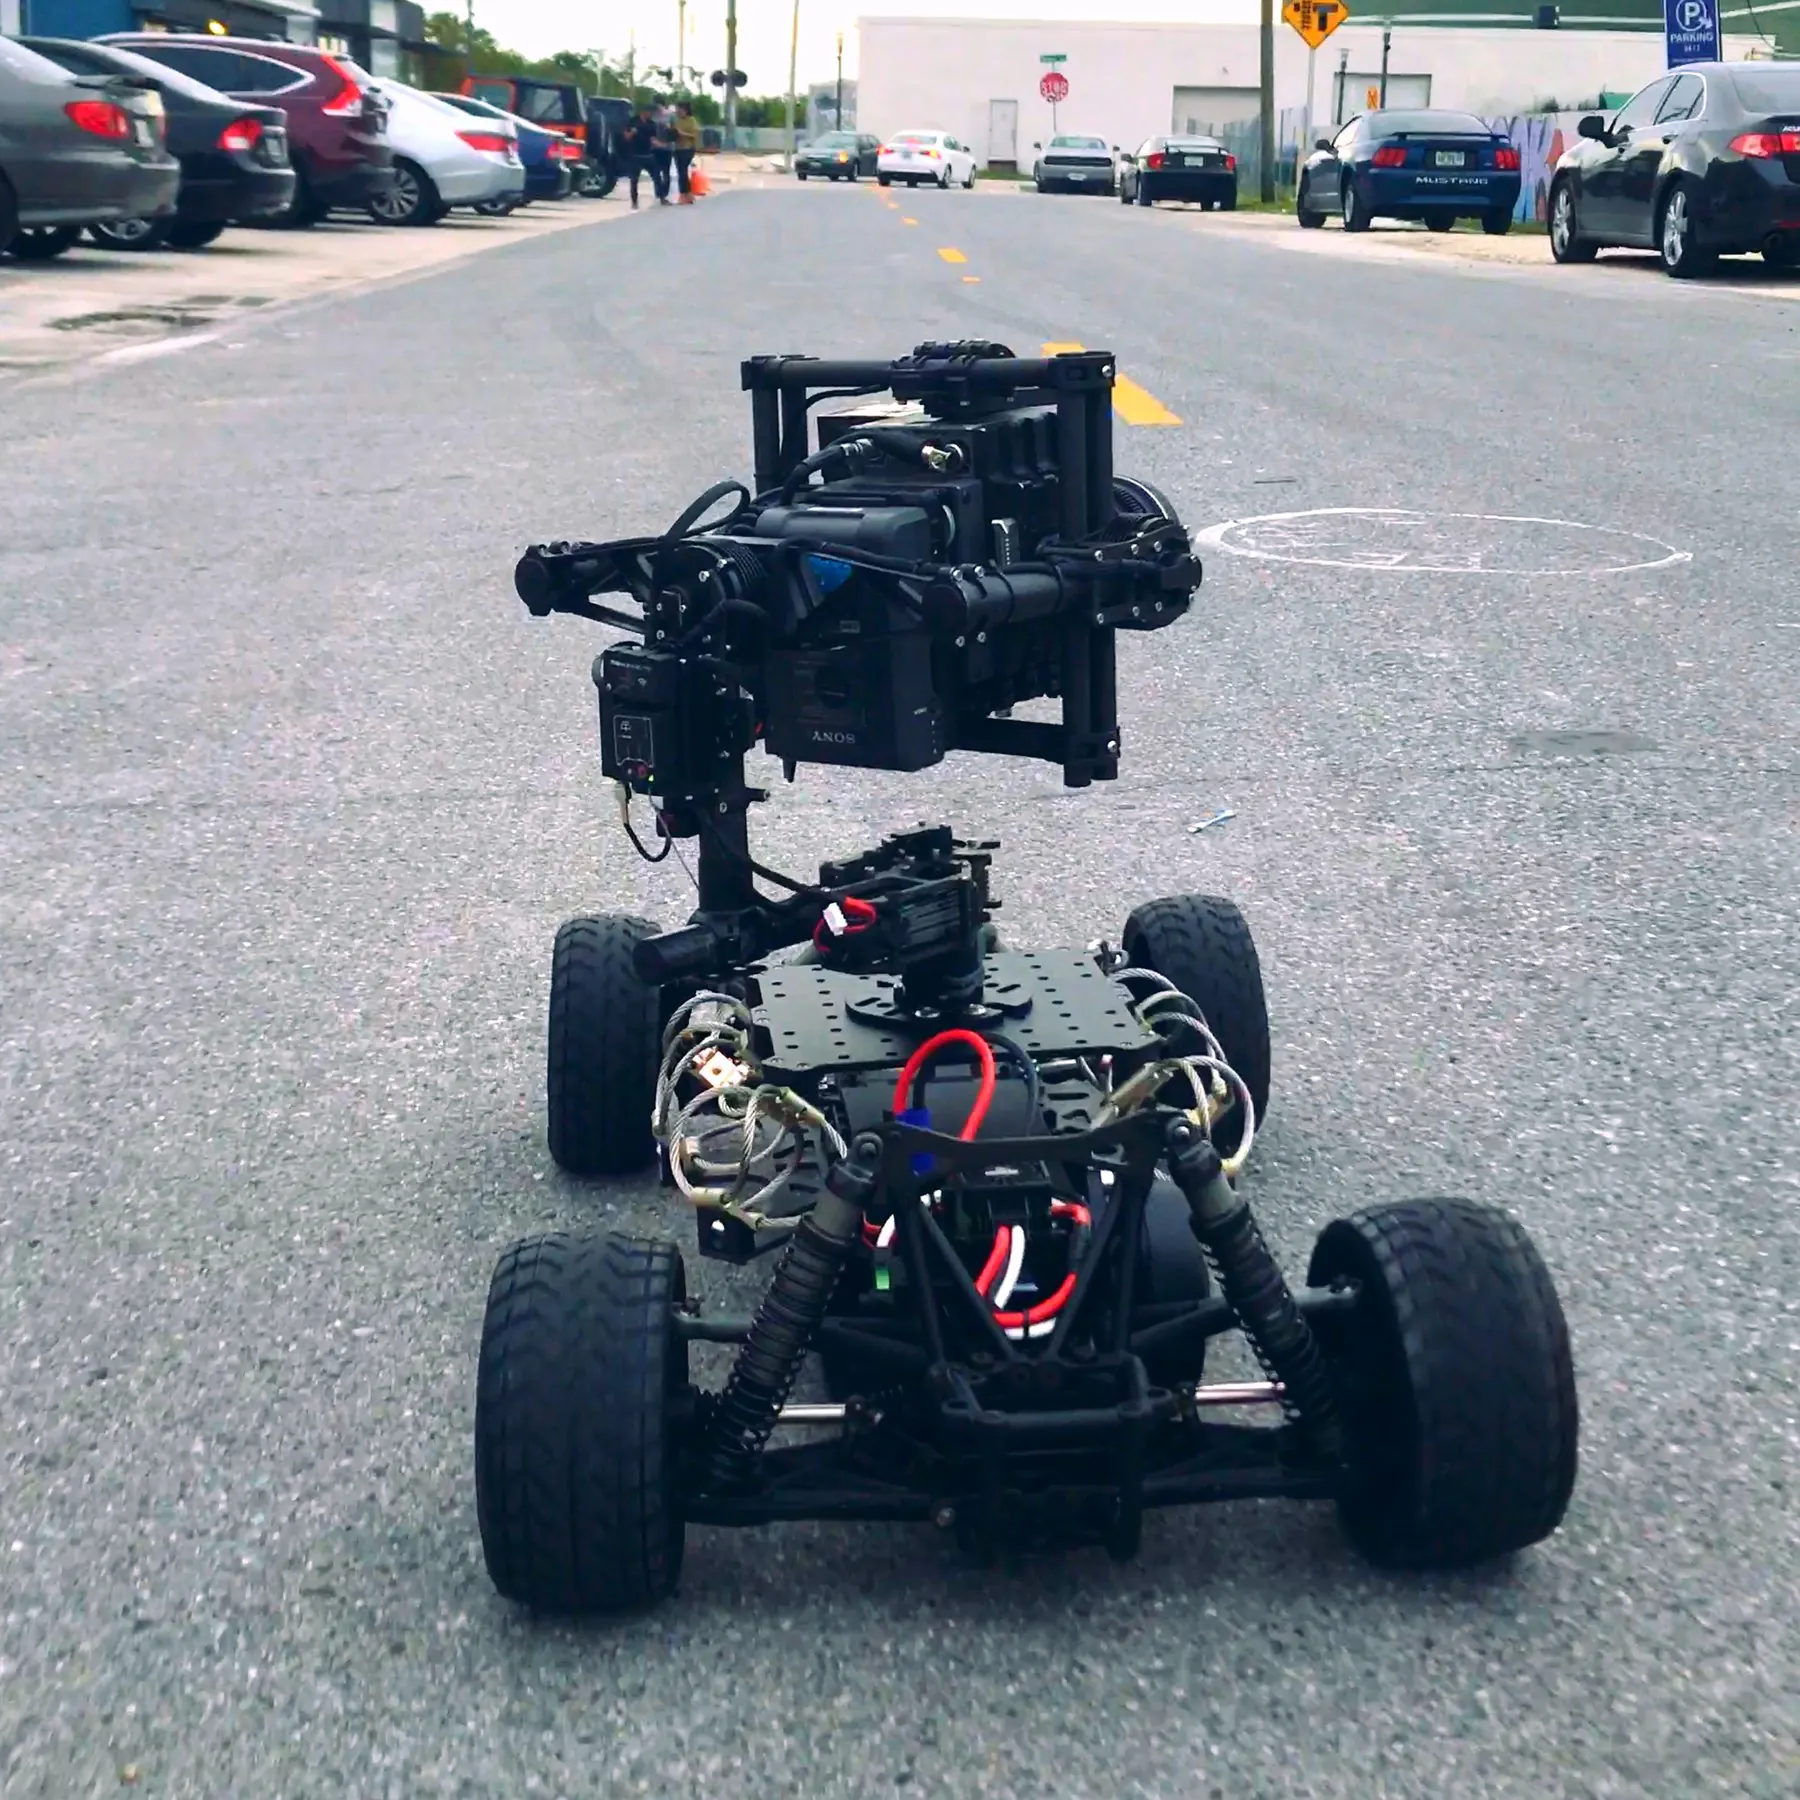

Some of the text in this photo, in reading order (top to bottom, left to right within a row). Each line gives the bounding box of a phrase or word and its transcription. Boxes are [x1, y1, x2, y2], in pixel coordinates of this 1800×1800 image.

[1670, 32, 1714, 43] PARKING
[1416, 176, 1488, 185] MUSTANG
[812, 731, 856, 744] SONY
